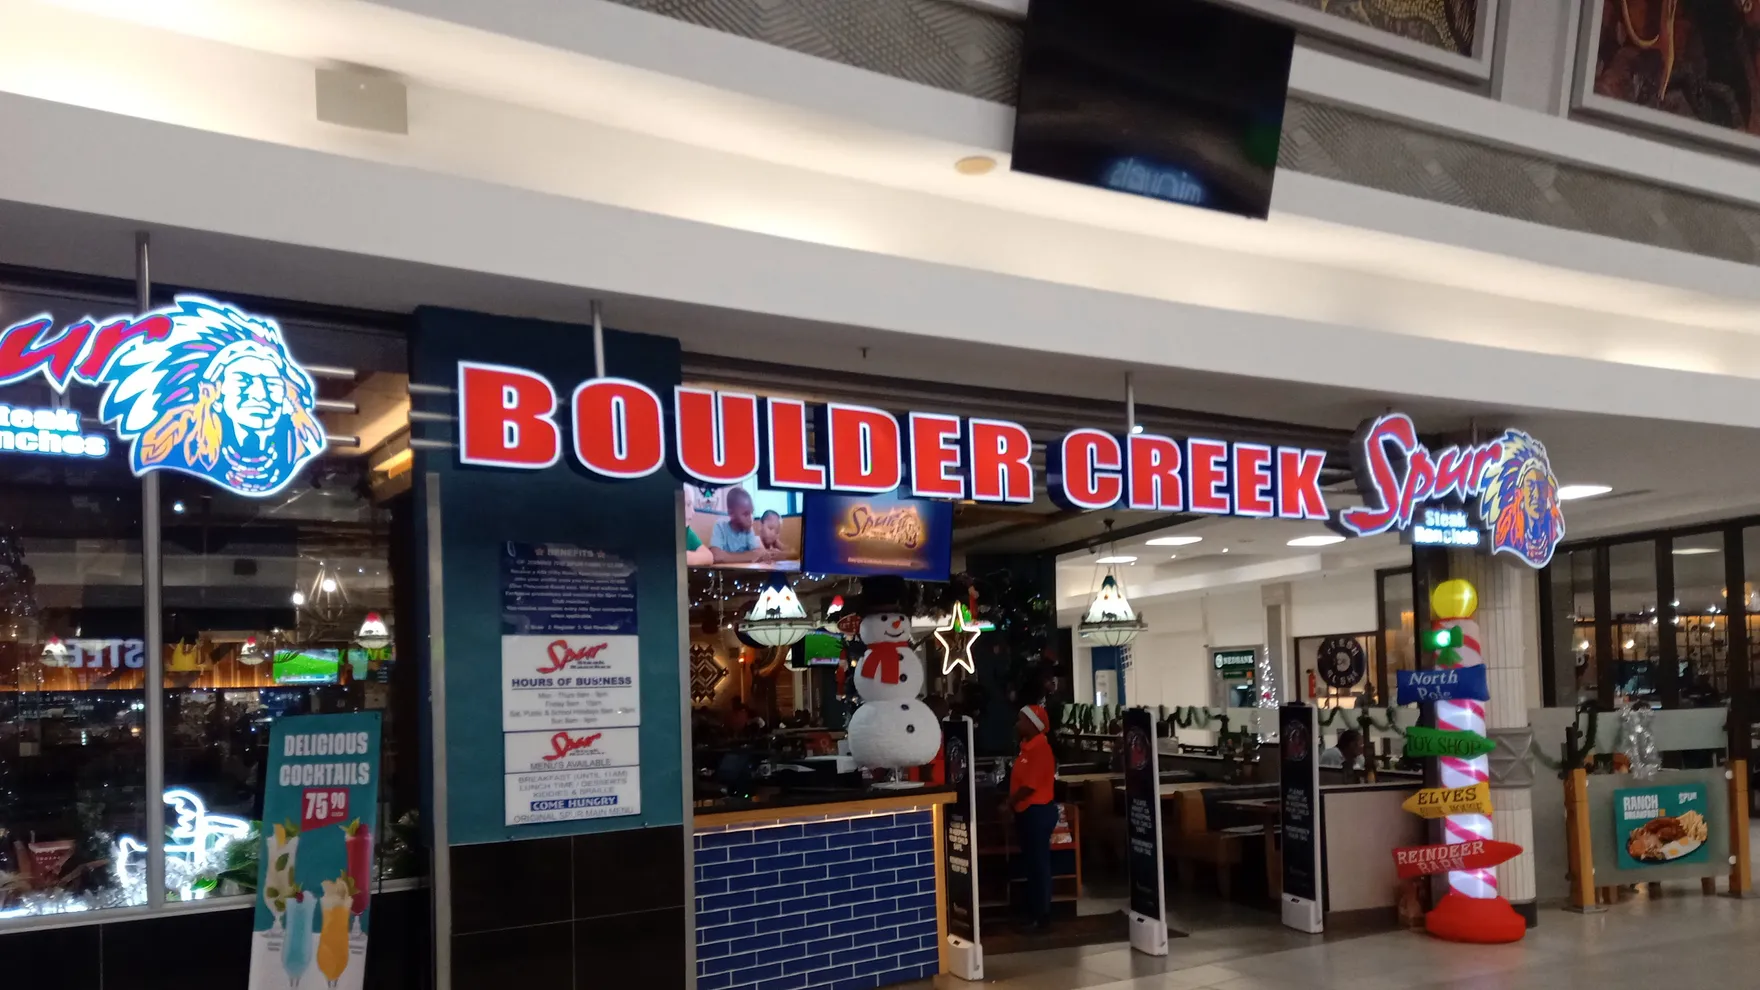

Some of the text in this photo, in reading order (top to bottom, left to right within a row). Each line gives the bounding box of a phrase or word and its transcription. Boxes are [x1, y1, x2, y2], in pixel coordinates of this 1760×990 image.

[458, 360, 1330, 520] BOULDER CREEK
[1340, 412, 1505, 537] Spur
[1425, 509, 1467, 527] Steak
[536, 639, 608, 674] Spur
[1223, 654, 1254, 665] NEDBANK
[511, 676, 632, 687] HOURS OF BUSINESS
[1409, 669, 1458, 686] North
[1417, 685, 1453, 700] Pole
[284, 731, 369, 757] DELICIOUS
[530, 758, 611, 771] MENU'S AVAILABLE
[279, 762, 370, 787] COCKTAILS
[518, 774, 571, 784] BREAKFAST
[519, 783, 551, 792] LUNCH
[581, 778, 627, 787] DESSERTS
[580, 787, 615, 795] BRAILLE
[532, 797, 616, 811] COME HUNGRY
[1417, 787, 1477, 805] ELVES
[1623, 794, 1659, 810] RANCH
[305, 792, 345, 820] 75 90
[513, 814, 555, 823] ORIGINAL
[1397, 841, 1485, 865] REINDEER
